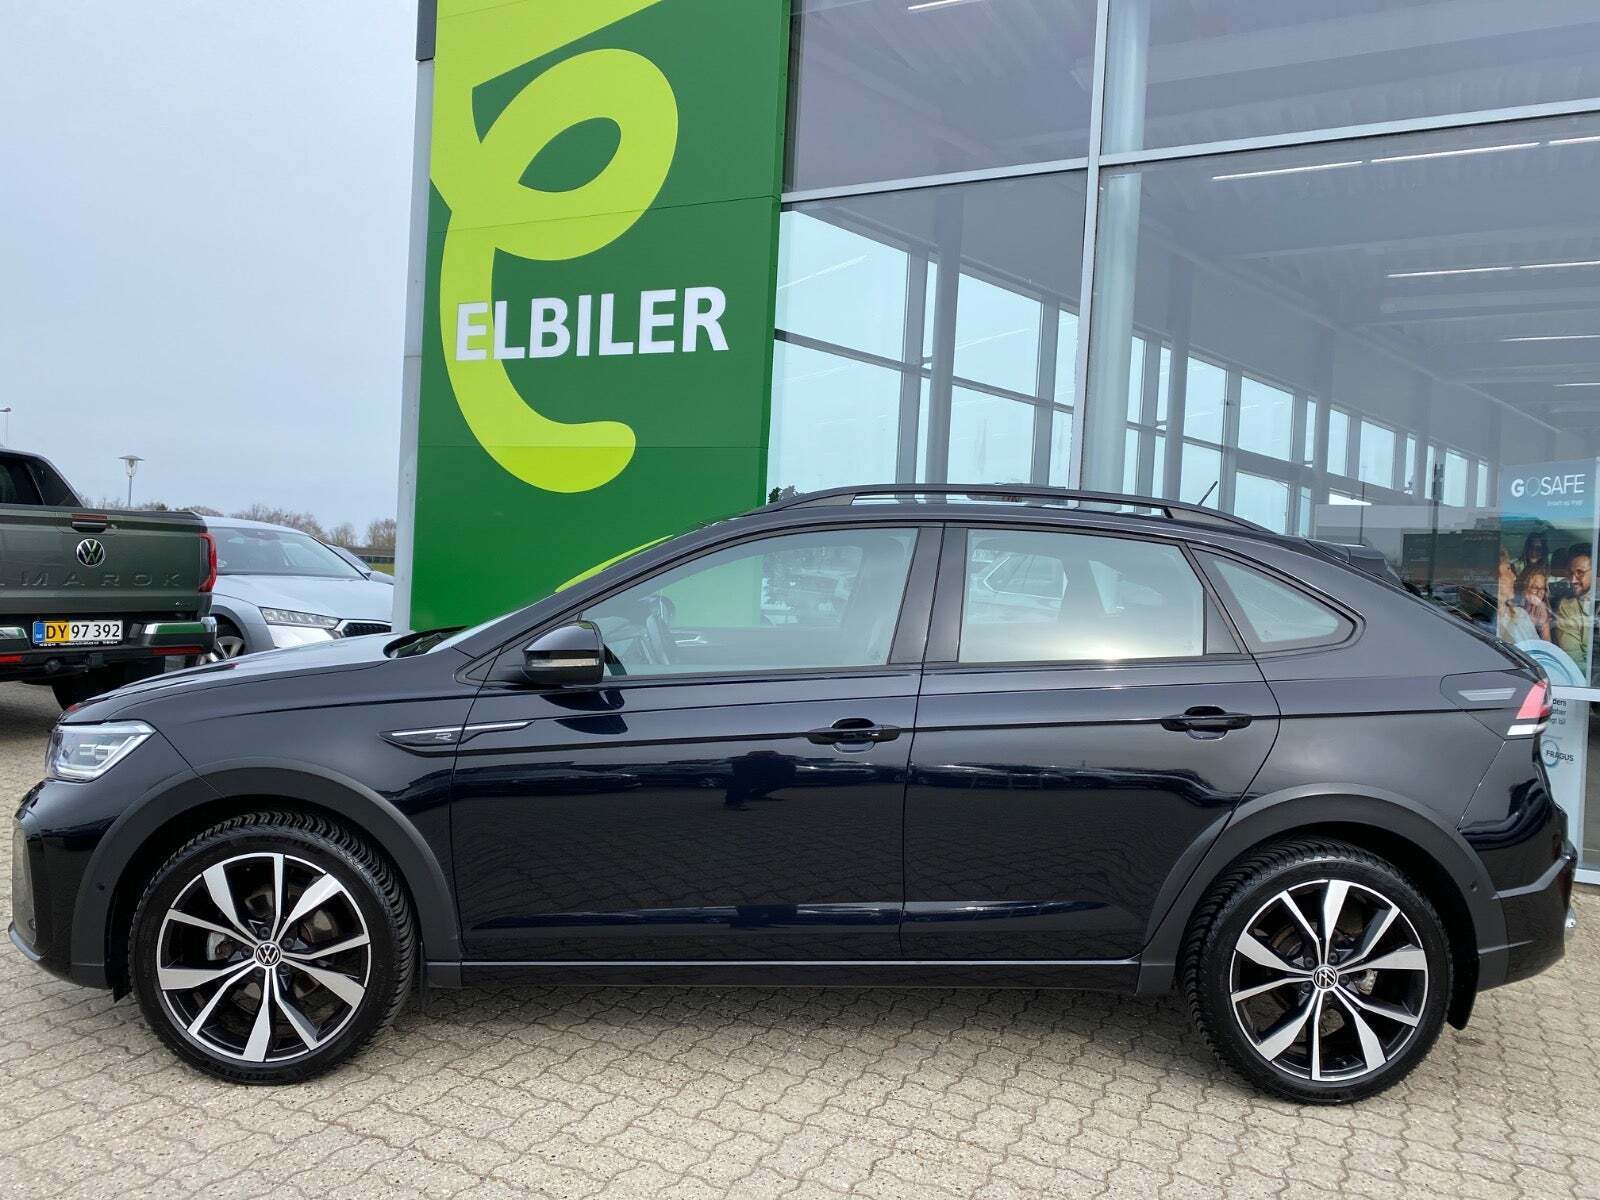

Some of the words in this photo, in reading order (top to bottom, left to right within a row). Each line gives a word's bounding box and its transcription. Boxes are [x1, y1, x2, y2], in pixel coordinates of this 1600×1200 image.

[456, 286, 729, 361] ELBILER
[1511, 474, 1586, 497] GOSAFE
[0, 571, 182, 587] MAROK
[46, 624, 68, 639] DY
[1546, 750, 1575, 761] FRAGUS
